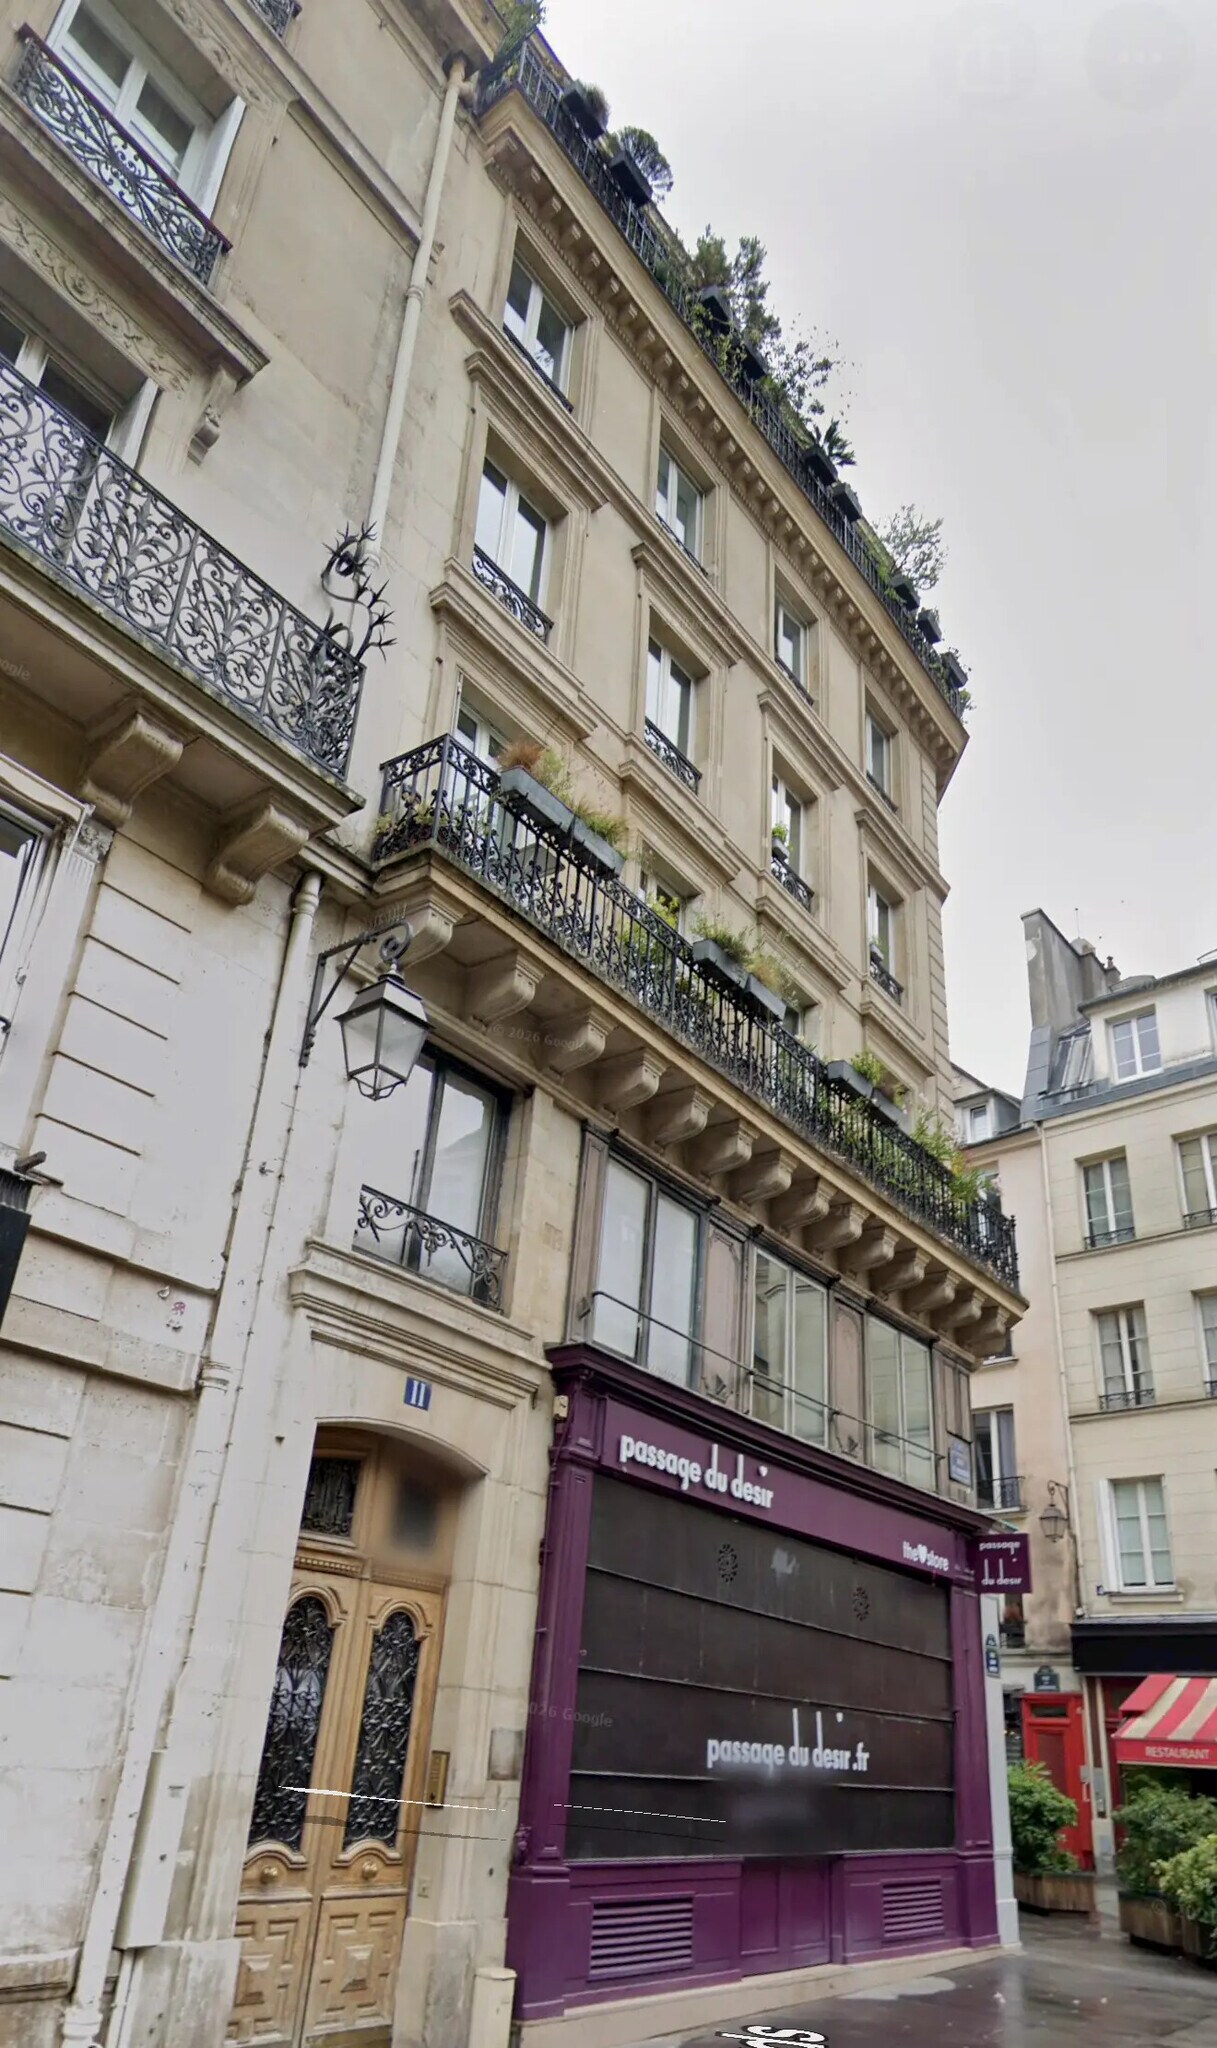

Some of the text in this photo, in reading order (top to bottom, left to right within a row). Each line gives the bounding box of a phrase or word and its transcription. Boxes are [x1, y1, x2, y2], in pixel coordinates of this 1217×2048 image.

[410, 1380, 426, 1407] 11
[619, 1435, 702, 1490] passage
[704, 1443, 728, 1492] du
[979, 1541, 1020, 1555] passage
[981, 1558, 995, 1585] du
[706, 1738, 785, 1775] passage
[788, 1707, 809, 1767] du
[1145, 1746, 1210, 1760] RESTAURANT
